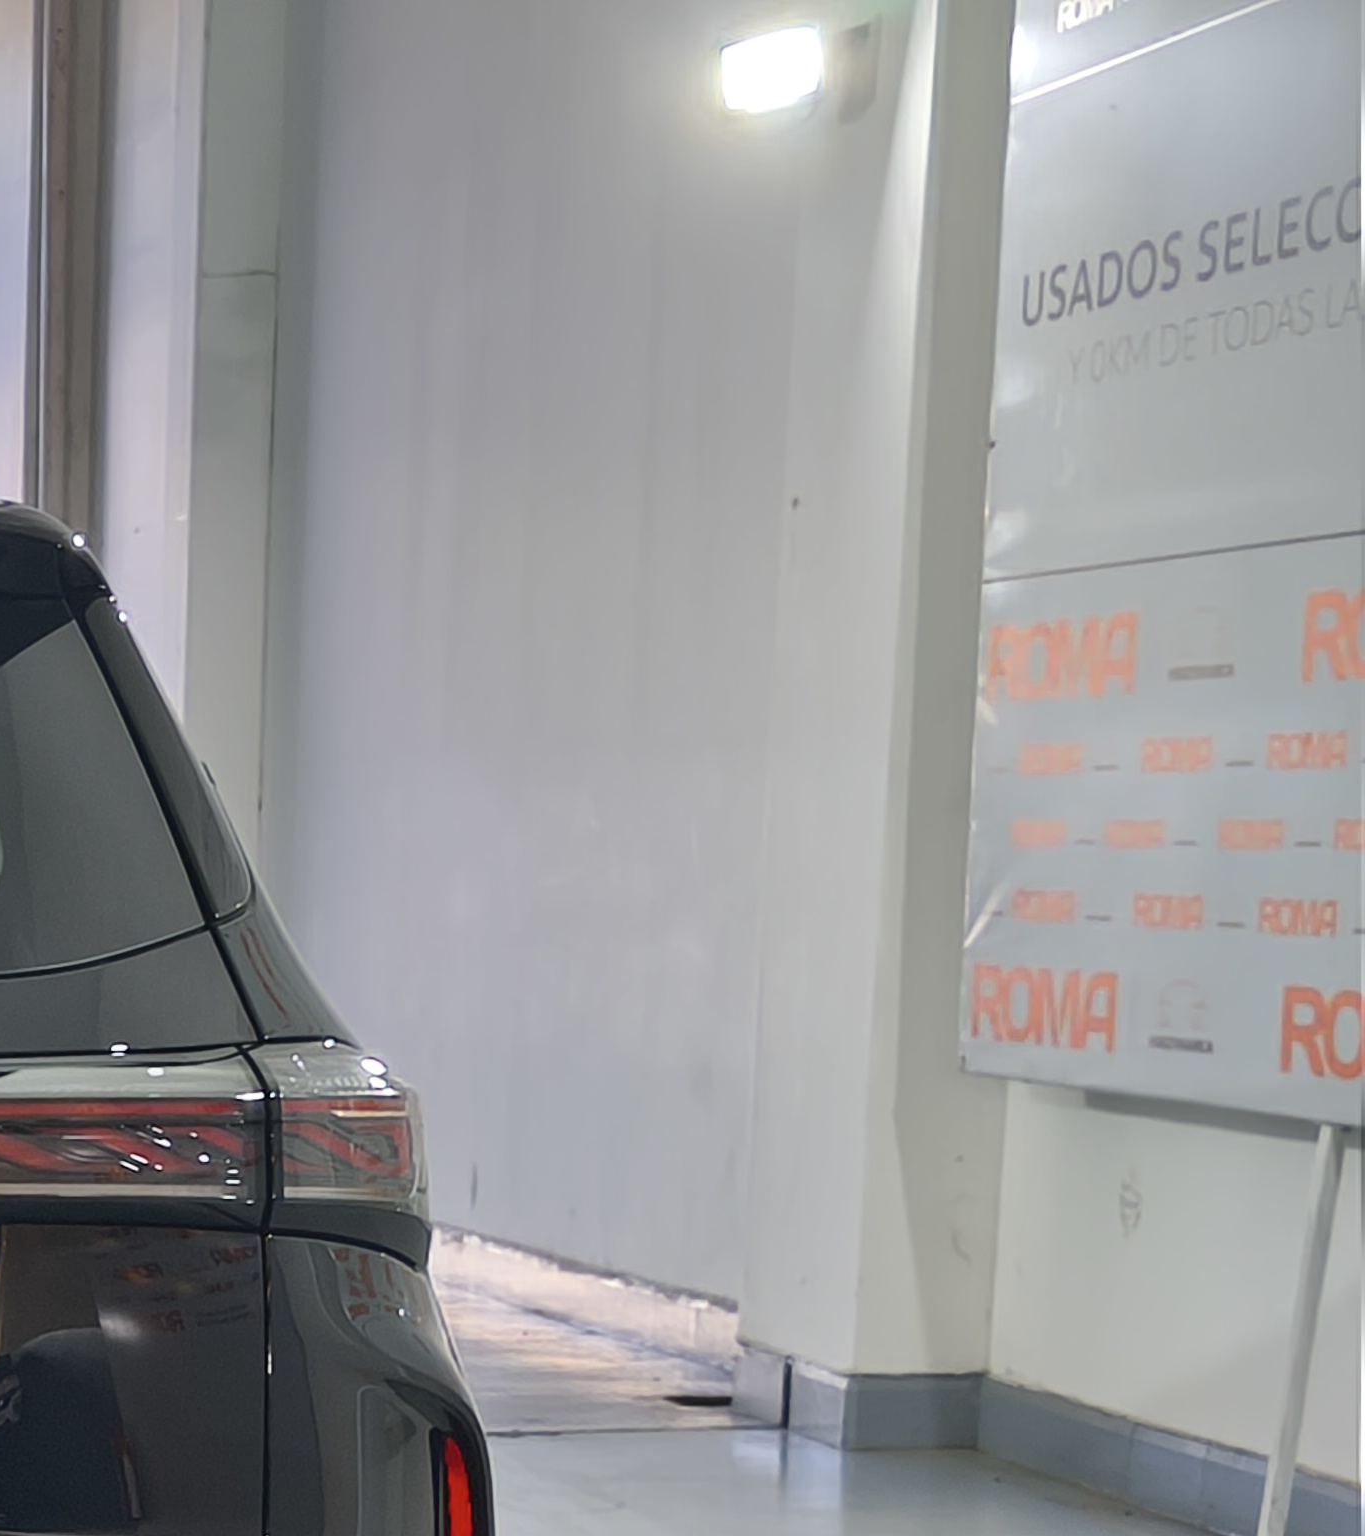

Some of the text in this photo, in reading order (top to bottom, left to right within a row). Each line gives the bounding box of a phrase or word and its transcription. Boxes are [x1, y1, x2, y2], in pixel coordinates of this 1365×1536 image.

[1021, 230, 1183, 327] USADOS
[1159, 316, 1199, 368] DE
[1208, 288, 1315, 354] TODAS
[985, 610, 1139, 703] ROMA
[1267, 730, 1348, 770] ROMA
[1257, 896, 1338, 937] ROMA
[971, 962, 1119, 1054] ROMA
